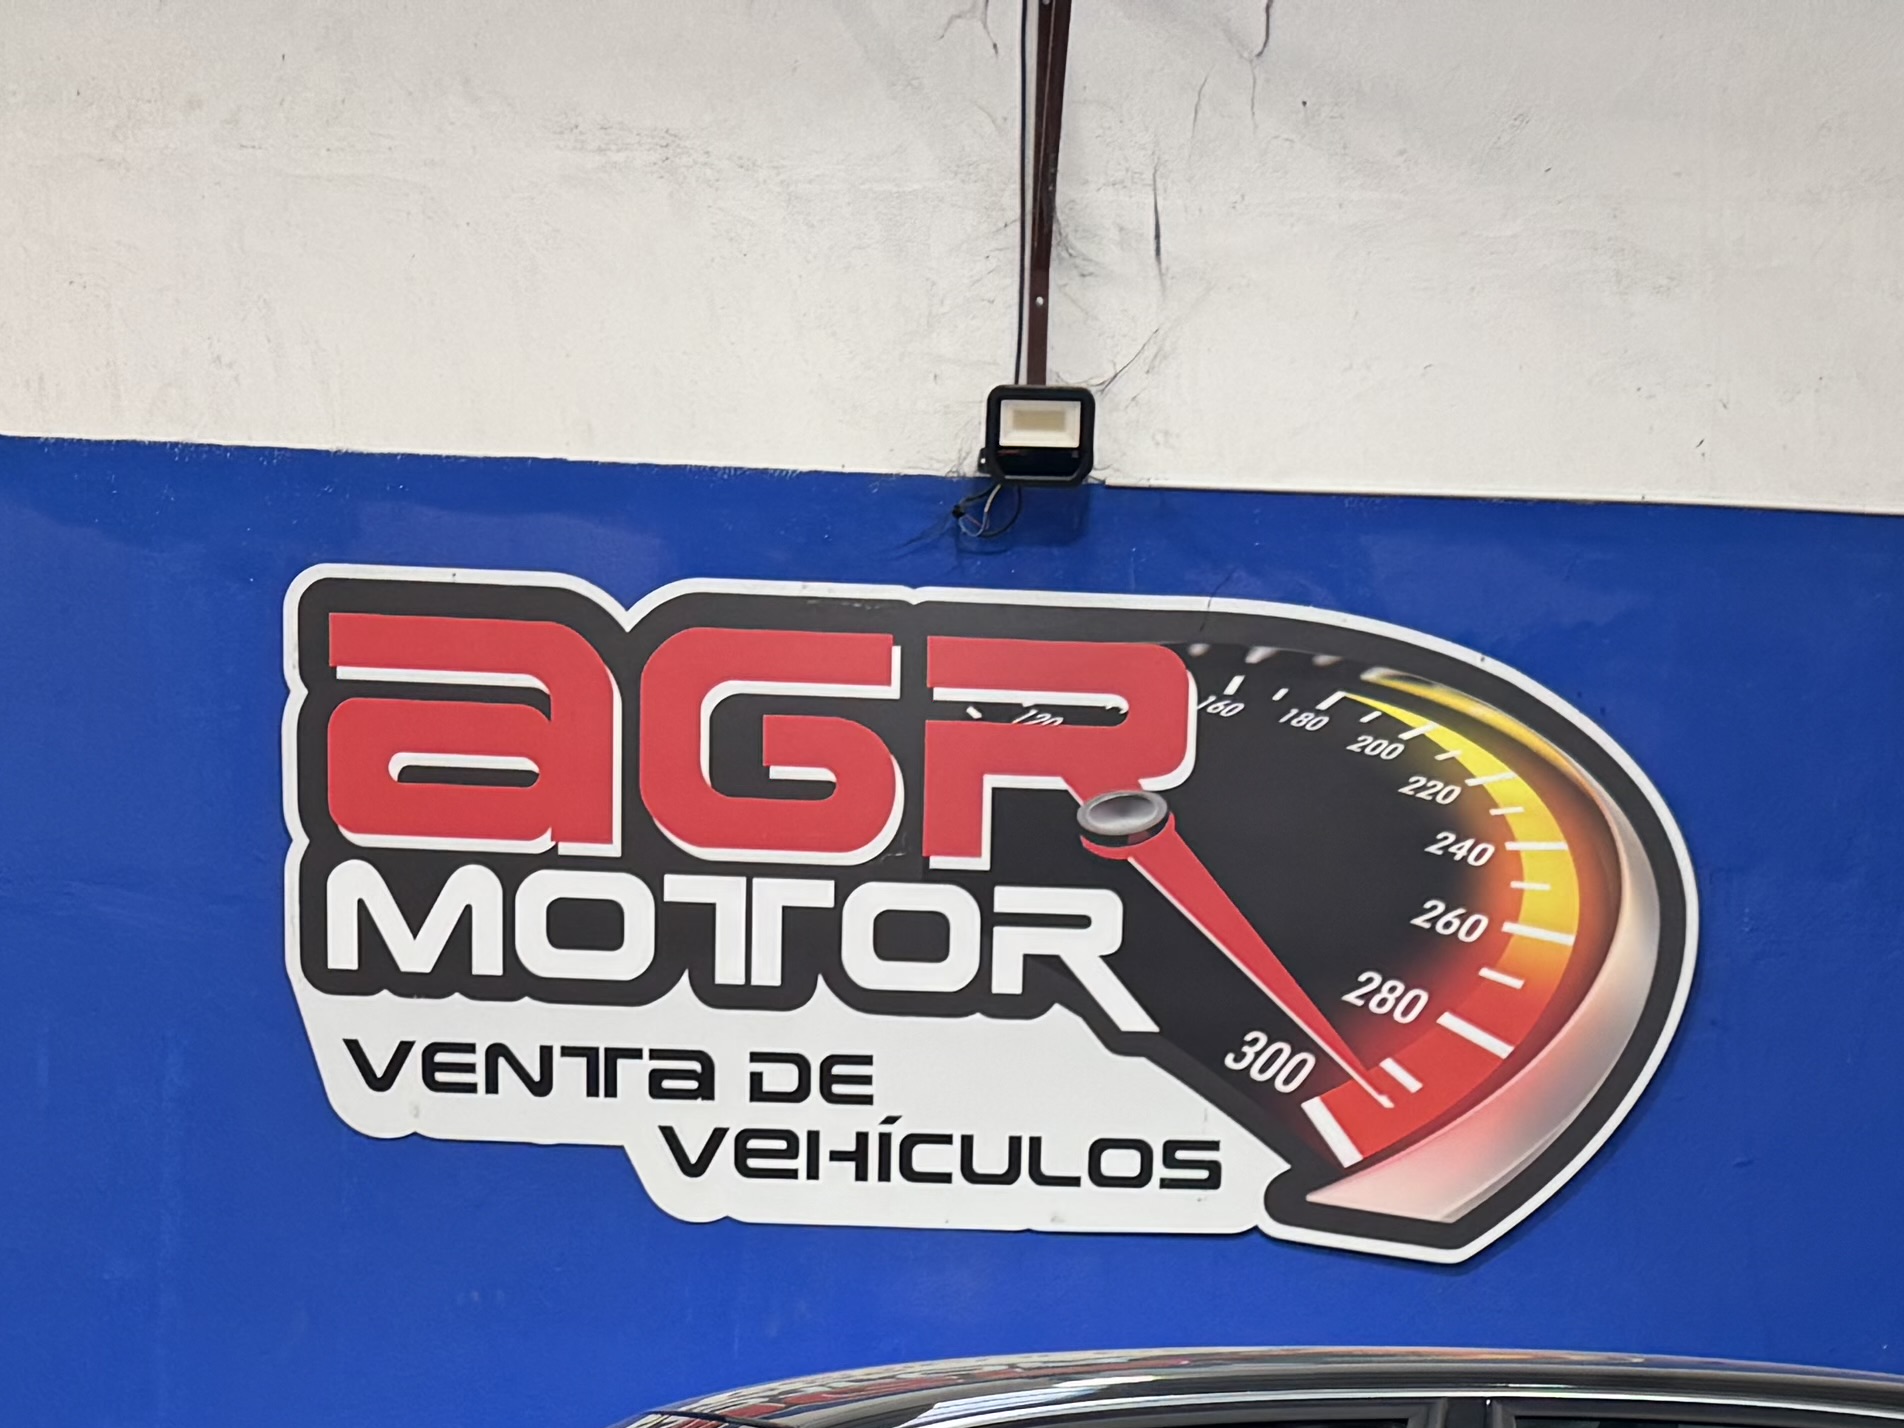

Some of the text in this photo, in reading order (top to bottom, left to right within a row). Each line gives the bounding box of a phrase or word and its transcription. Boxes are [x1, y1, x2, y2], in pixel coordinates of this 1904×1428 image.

[1196, 694, 1245, 718] 160
[1278, 707, 1330, 732] 180
[1346, 735, 1405, 761] 200
[1398, 776, 1462, 806] 220
[1424, 831, 1495, 867] 240
[1409, 899, 1489, 943] 260
[327, 859, 1160, 1032] MOTOR
[1341, 971, 1429, 1024] 280
[748, 1050, 875, 1106] DE
[1224, 1031, 1316, 1093] 300
